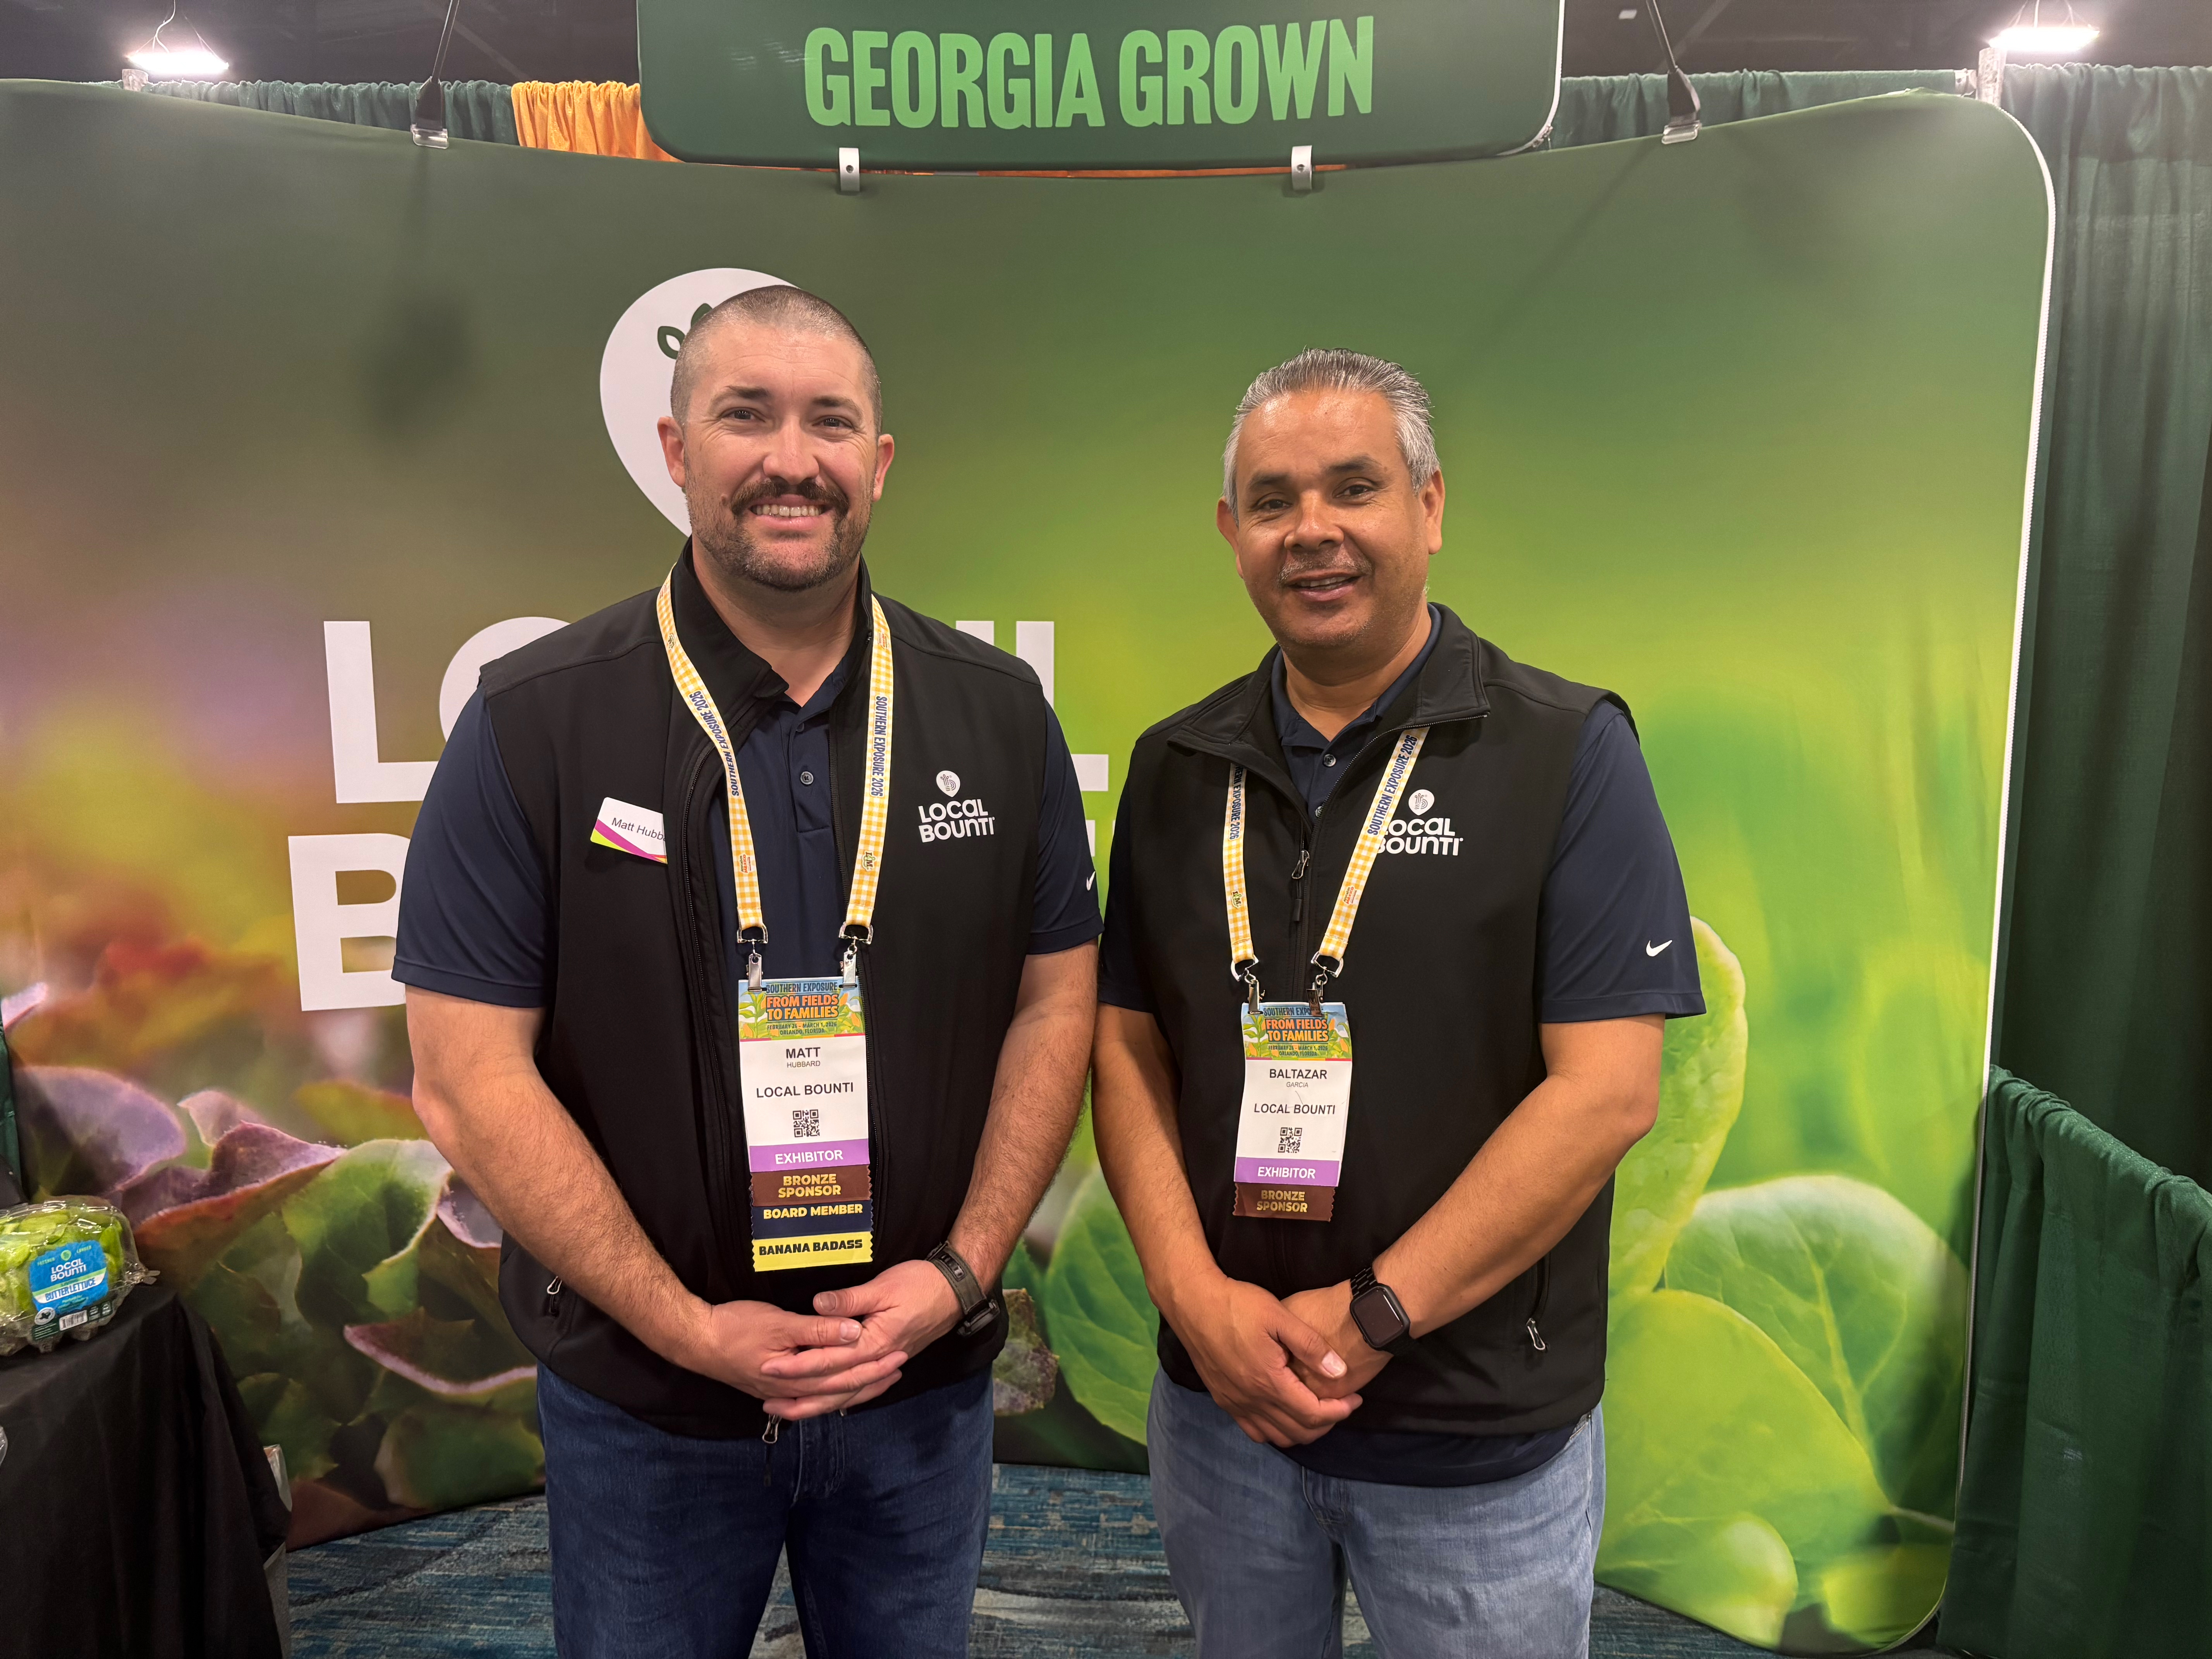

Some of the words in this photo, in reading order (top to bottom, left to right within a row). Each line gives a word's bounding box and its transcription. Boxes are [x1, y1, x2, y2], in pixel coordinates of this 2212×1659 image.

[805, 27, 1105, 129] GEORGIA
[1119, 15, 1374, 127] GROWN
[689, 690, 709, 711] 2026
[874, 696, 888, 736] SOUTHERN
[700, 710, 728, 749] EXPOSURE
[872, 737, 885, 777] EXPOSURE
[723, 751, 739, 796] SOUTHERN
[871, 778, 884, 797] 2026
[1367, 793, 1393, 835] SOUTHERN
[1384, 754, 1410, 795] EXPOSURE
[1400, 735, 1418, 756] 2026
[1231, 785, 1241, 822] EXPOSURE
[612, 817, 634, 831] Matt
[1229, 822, 1240, 840] 2026
[1385, 818, 1455, 836] OCAL
[864, 852, 876, 867] L&M
[766, 983, 801, 993] SOUTHERN
[803, 982, 837, 992] EXPOSURE
[767, 996, 800, 1008] FROM
[802, 994, 838, 1006] FIELDS
[767, 1008, 782, 1020] TO
[785, 1006, 838, 1019] FAMILIES
[1263, 1007, 1294, 1016] SOUTHERN
[1266, 1019, 1295, 1029] FROM
[1297, 1019, 1328, 1029] FIELDS
[1267, 1030, 1281, 1041] TO
[1283, 1030, 1329, 1041] FAMILIES
[786, 1047, 821, 1059] MATT
[1269, 1069, 1327, 1079] BALTAZAR
[756, 1085, 800, 1098] LOCAL
[805, 1082, 854, 1095] BOUNTI
[1254, 1103, 1290, 1114] LOCAL
[1293, 1104, 1335, 1115] BOUNTI
[775, 1149, 843, 1164] EXHIBITOR
[783, 1174, 836, 1186] BRONZE
[1258, 1167, 1316, 1179] EXHIBITOR
[778, 1185, 841, 1198] SPONSOR
[1261, 1190, 1305, 1201] BRONZE
[763, 1208, 807, 1219] BOARD
[811, 1204, 863, 1216] MEMBER
[1256, 1201, 1308, 1212] SPONSOR
[759, 1243, 810, 1255] BANANA
[813, 1239, 862, 1252] BADASS
[45, 1286, 70, 1301] BUTTER
[69, 1278, 96, 1293] LETTUCE
